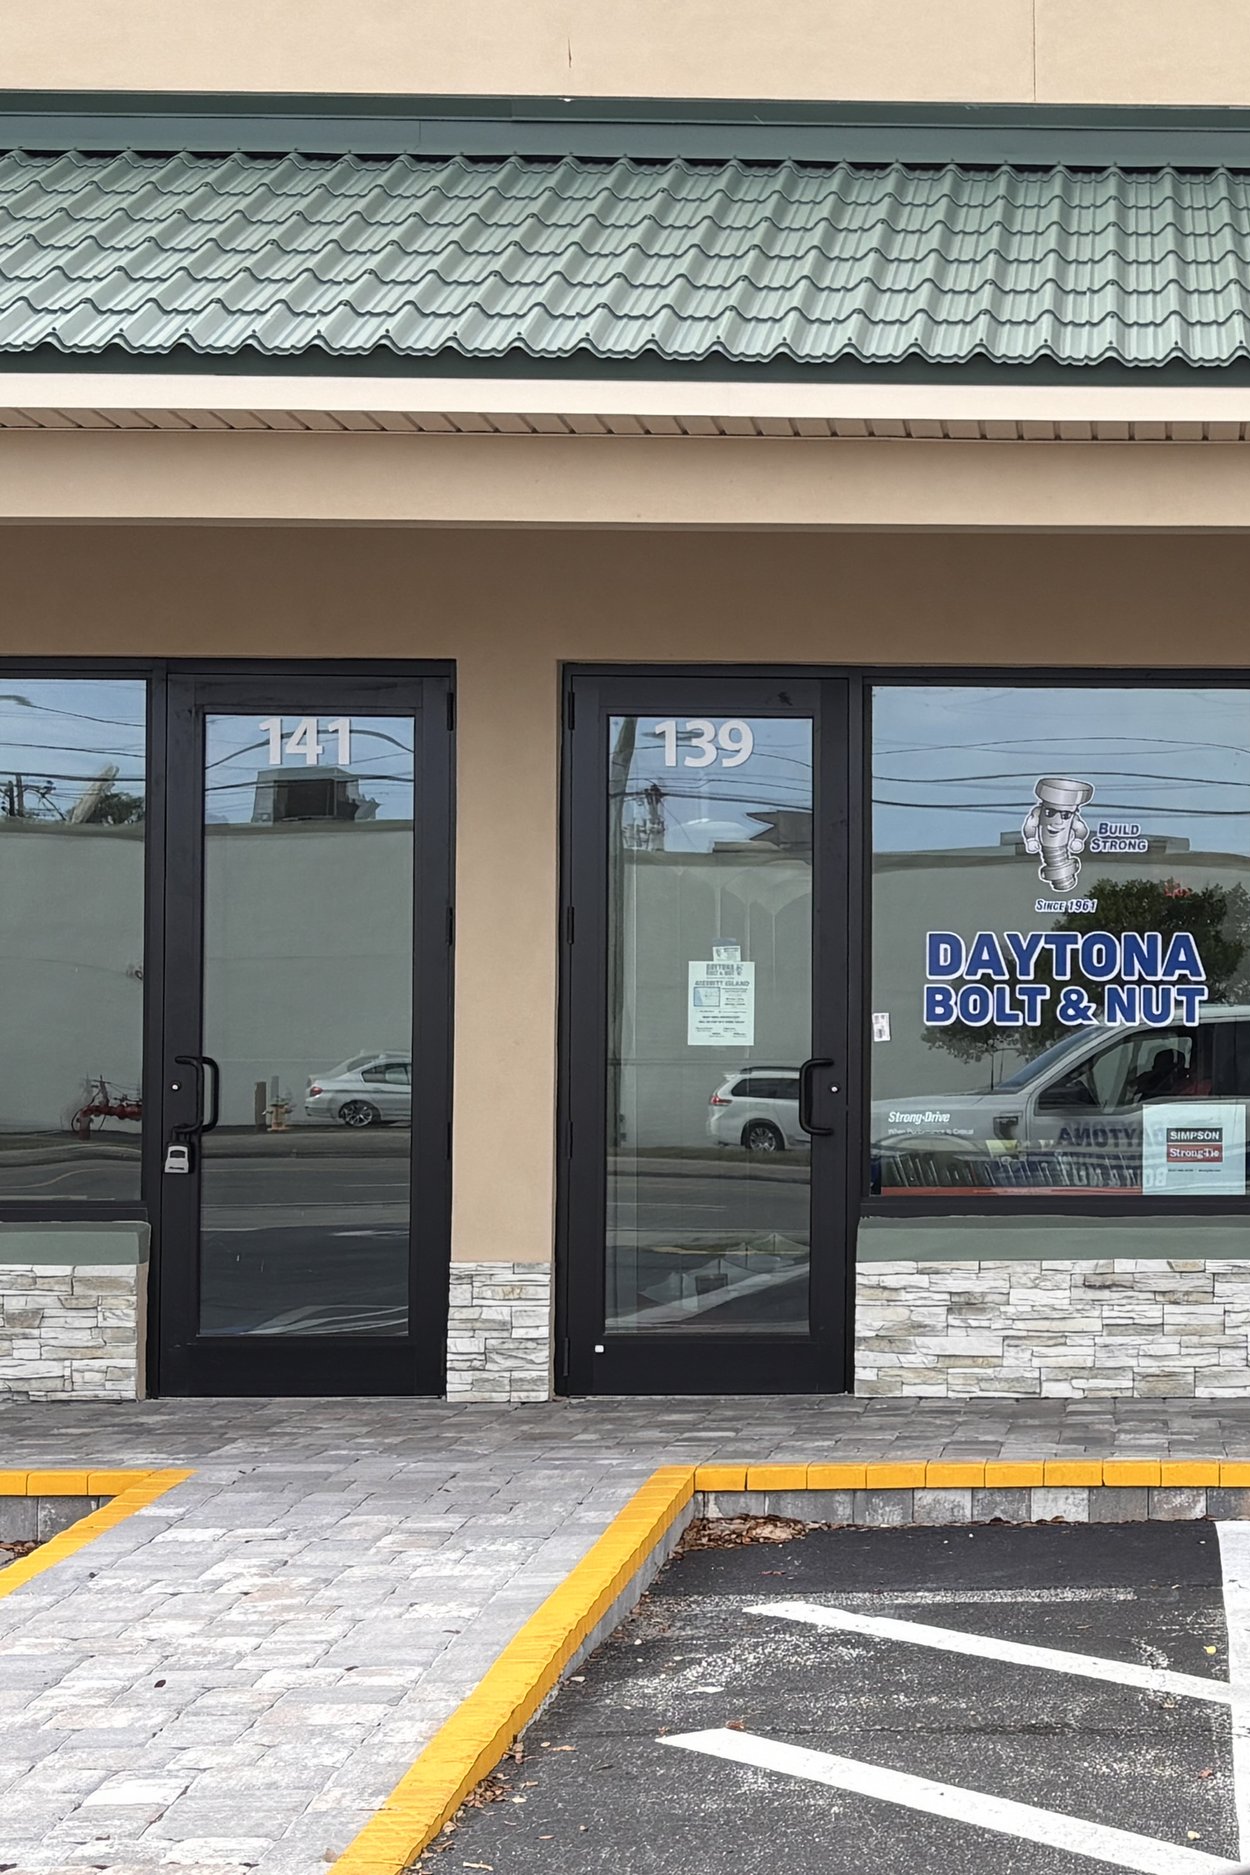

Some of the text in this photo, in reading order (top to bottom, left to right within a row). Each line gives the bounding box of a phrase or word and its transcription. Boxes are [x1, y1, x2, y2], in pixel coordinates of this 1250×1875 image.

[259, 717, 351, 765] 141
[654, 719, 754, 767] 139
[1098, 822, 1140, 836] BUILD
[1091, 838, 1147, 851] STRONG
[1035, 899, 1097, 912] SINCE 1961
[926, 931, 1206, 980] DAYTONA
[923, 984, 1208, 1027] BOLT & NUT
[1170, 1131, 1220, 1140] SIMPSON
